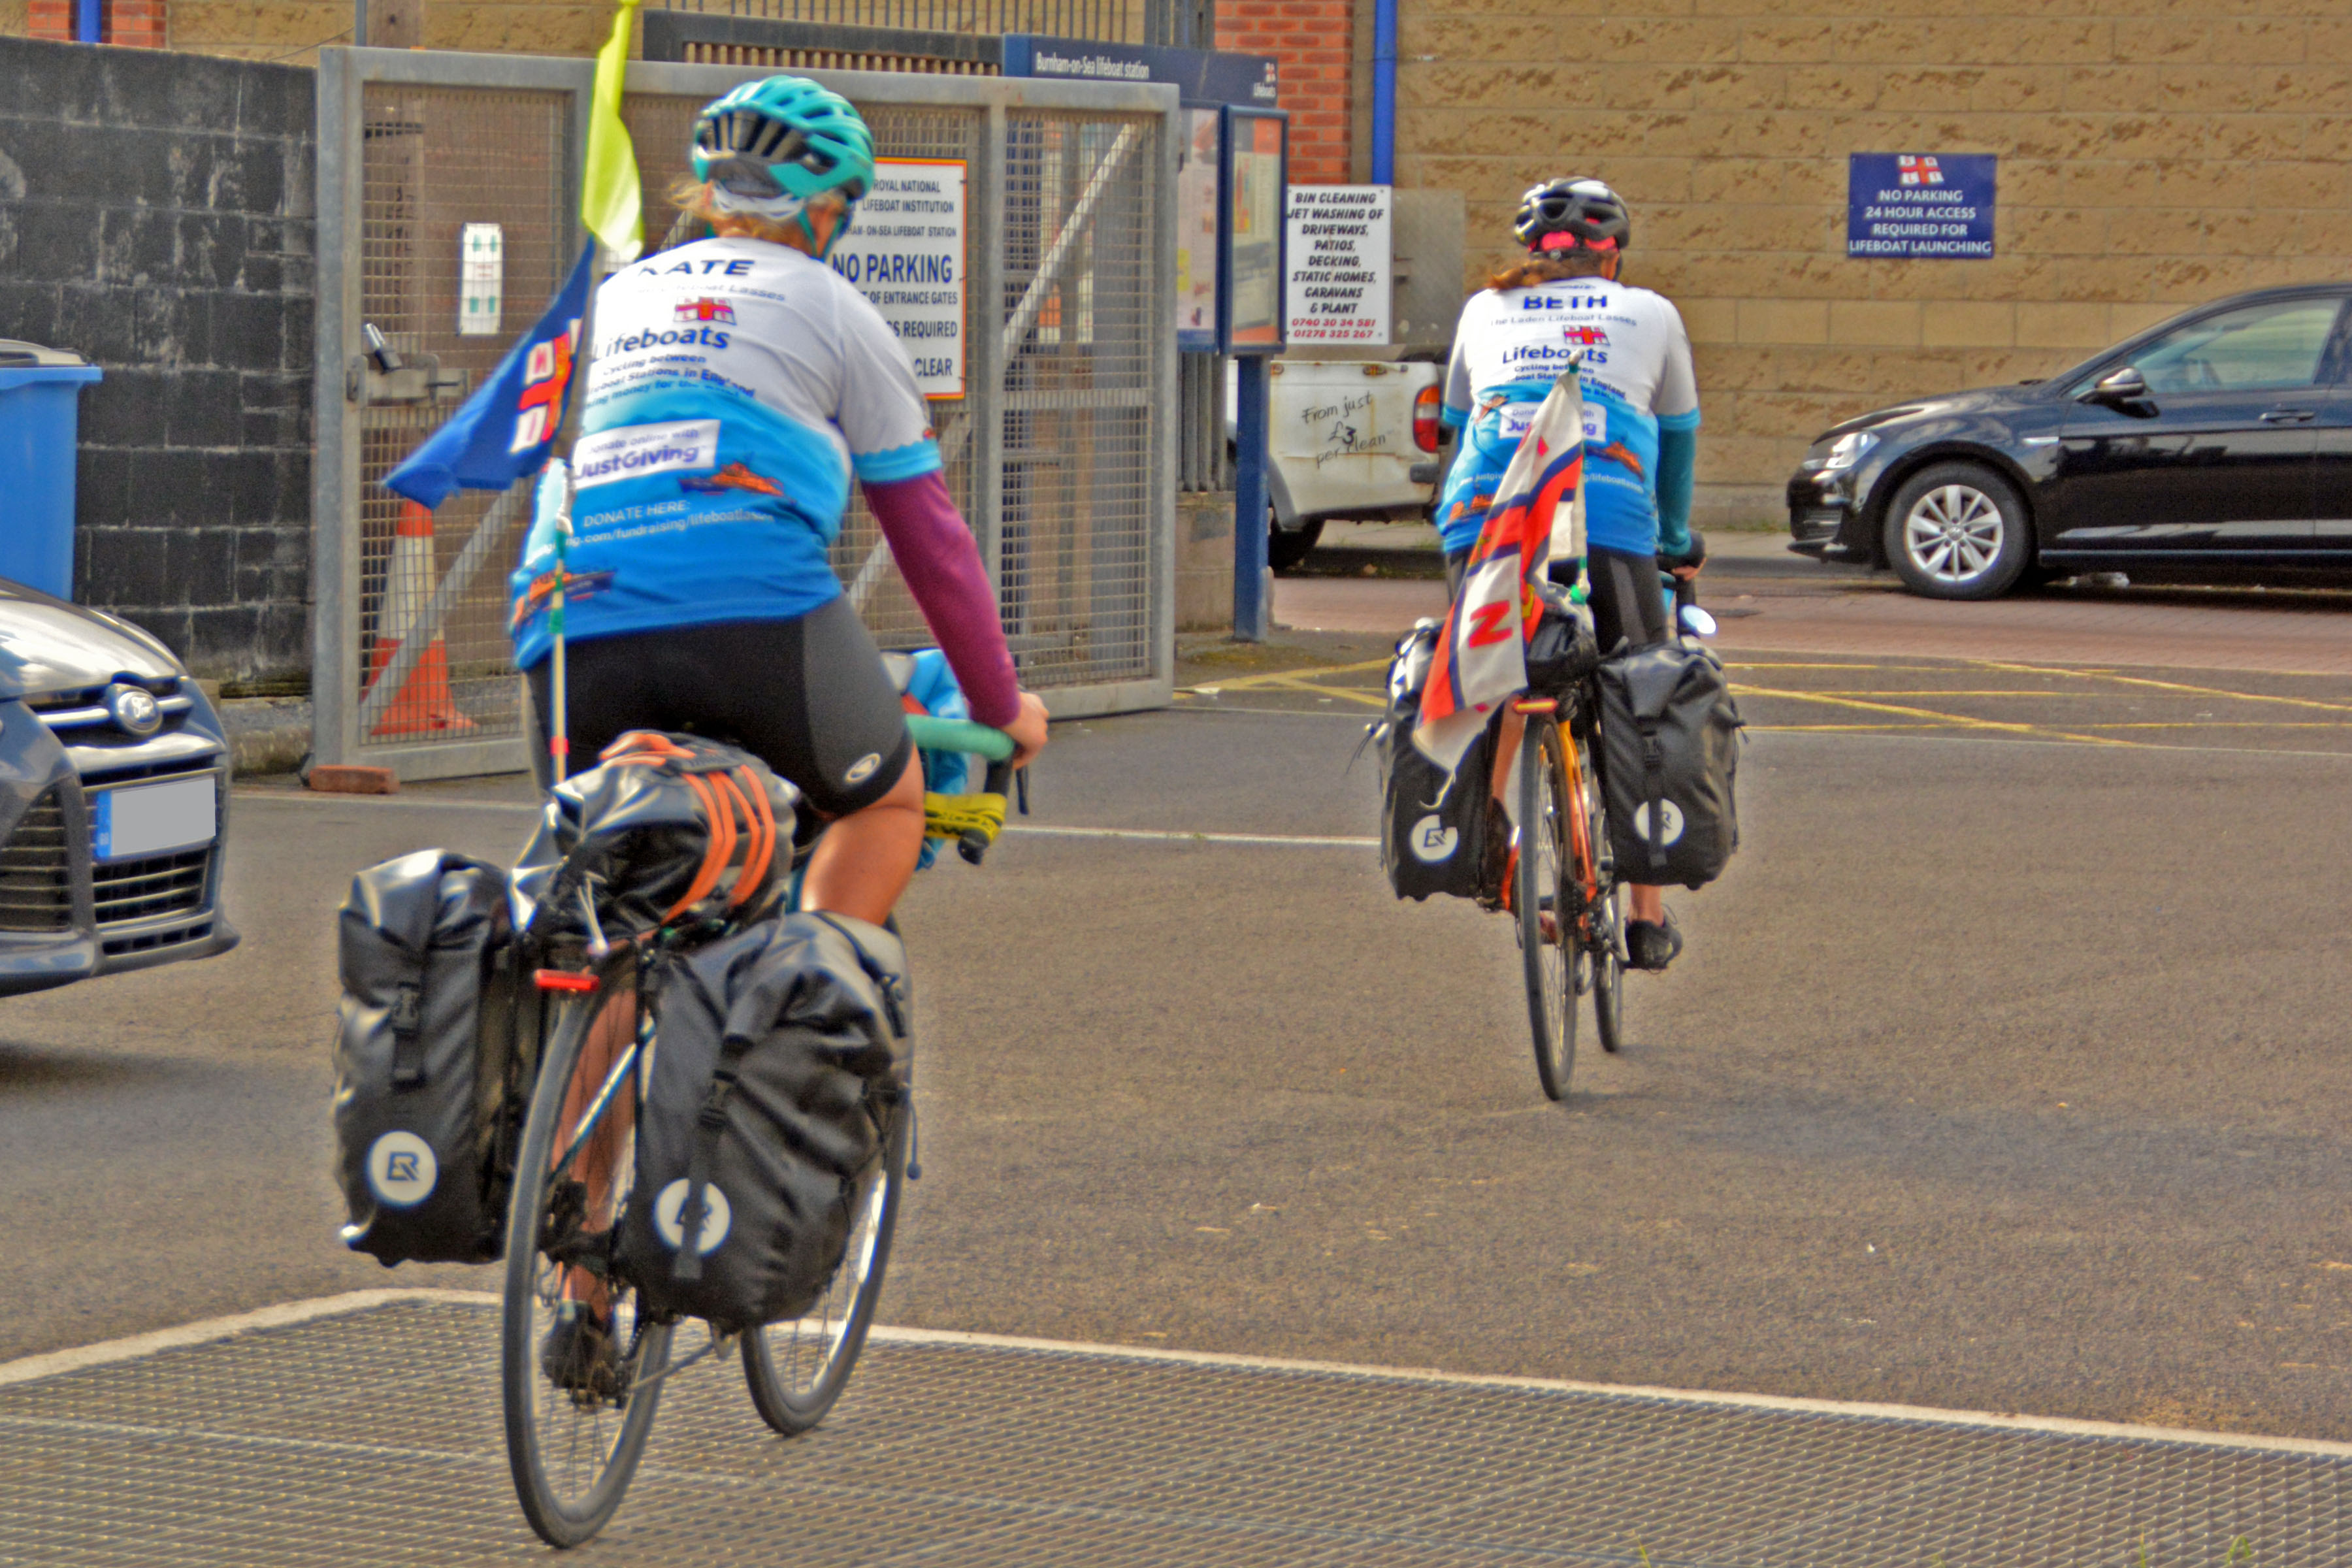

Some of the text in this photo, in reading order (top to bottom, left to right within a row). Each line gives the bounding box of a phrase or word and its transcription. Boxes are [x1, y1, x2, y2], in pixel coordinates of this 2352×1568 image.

[1036, 52, 1149, 79] Burnham-on-Sea lifeboat station
[874, 179, 941, 193] ROYAL NATIONAL
[1295, 192, 1377, 204] BIN CLEANING
[1878, 189, 1963, 202] NO PARKING
[862, 199, 955, 213] LIFEBOAT INSTITUTION
[1287, 208, 1384, 220] JET WASHING OF
[1865, 206, 1976, 220] 24 HOUR ACCESS
[893, 226, 924, 237] LIFEBOAT
[928, 227, 956, 237] STATION
[1301, 224, 1369, 236] DRIVEWAYS,
[1872, 223, 1968, 237] REQUIRED FOR
[1315, 240, 1356, 252] PATIOS,
[1849, 240, 1991, 253] LIFEBOAT LAUNCHING
[832, 253, 952, 283] NO PARKING
[1309, 255, 1361, 268] DECKING,
[1292, 271, 1376, 284] STATIC HOMES,
[870, 292, 881, 304] OF
[884, 292, 930, 304] ENTRANCE
[931, 292, 958, 305] GATES
[1305, 287, 1364, 299] CARAVANS
[1321, 302, 1358, 314] PLANT
[1523, 295, 1609, 309] BETH
[1292, 318, 1320, 327] 0740
[1357, 319, 1376, 327] 581
[1511, 316, 1545, 325] Laden
[1548, 314, 1595, 323] Lifeboat
[1598, 314, 1637, 326] Lasses
[903, 321, 958, 338] REQUIRED
[1353, 330, 1373, 338] 267
[650, 354, 707, 364] between
[684, 367, 697, 377] in
[915, 358, 953, 376] CLEAR
[1514, 364, 1548, 372] Cycling
[655, 380, 676, 389] for
[1301, 391, 1373, 424] From just
[1328, 421, 1357, 445] £3
[575, 446, 700, 480] JustGiving
[1315, 449, 1340, 470] per
[583, 500, 691, 529] DONATE HERE:
